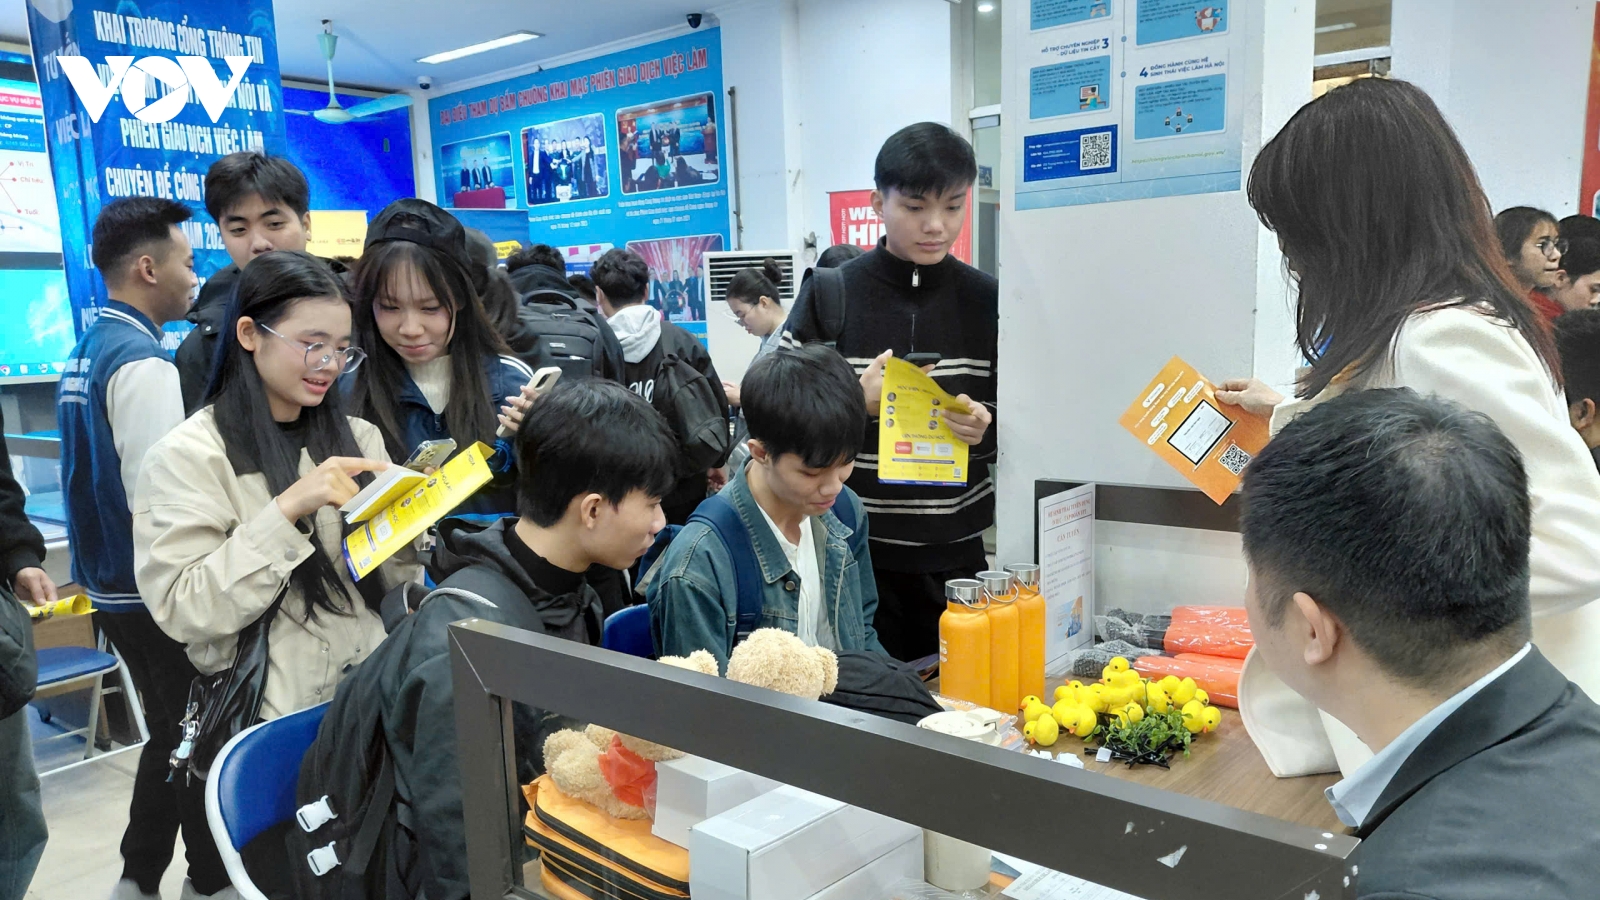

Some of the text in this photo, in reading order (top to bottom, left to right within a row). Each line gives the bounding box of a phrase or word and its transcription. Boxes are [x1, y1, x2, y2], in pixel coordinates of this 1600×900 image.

[93, 10, 264, 64] KHAI TRƯƠNG CỔNG THÔNG TIN
[1060, 41, 1080, 50] CHUYÊN
[1102, 37, 1109, 49] 3
[1139, 67, 1148, 78] 4
[1150, 63, 1166, 71] ĐỒNG
[1184, 58, 1200, 66] CÙNG
[1191, 63, 1203, 71] LÀM
[1204, 61, 1213, 69] HÀ
[468, 100, 488, 118] THAM
[518, 84, 548, 108] CHUÔNG
[549, 80, 568, 101] KHAI
[569, 75, 588, 99] MẠC
[590, 67, 616, 93] PHIÊN
[617, 63, 638, 87] GIAO
[640, 58, 661, 84] DỊCH
[662, 50, 685, 78] VIỆC
[686, 46, 708, 71] LÀM
[237, 77, 257, 117] NỘI
[256, 78, 273, 113] VÀ
[161, 122, 187, 151] GIAO
[186, 124, 213, 159] DỊCH
[105, 162, 154, 197] CHUYÊN
[174, 167, 201, 201] CÔNG
[205, 223, 226, 250] 202
